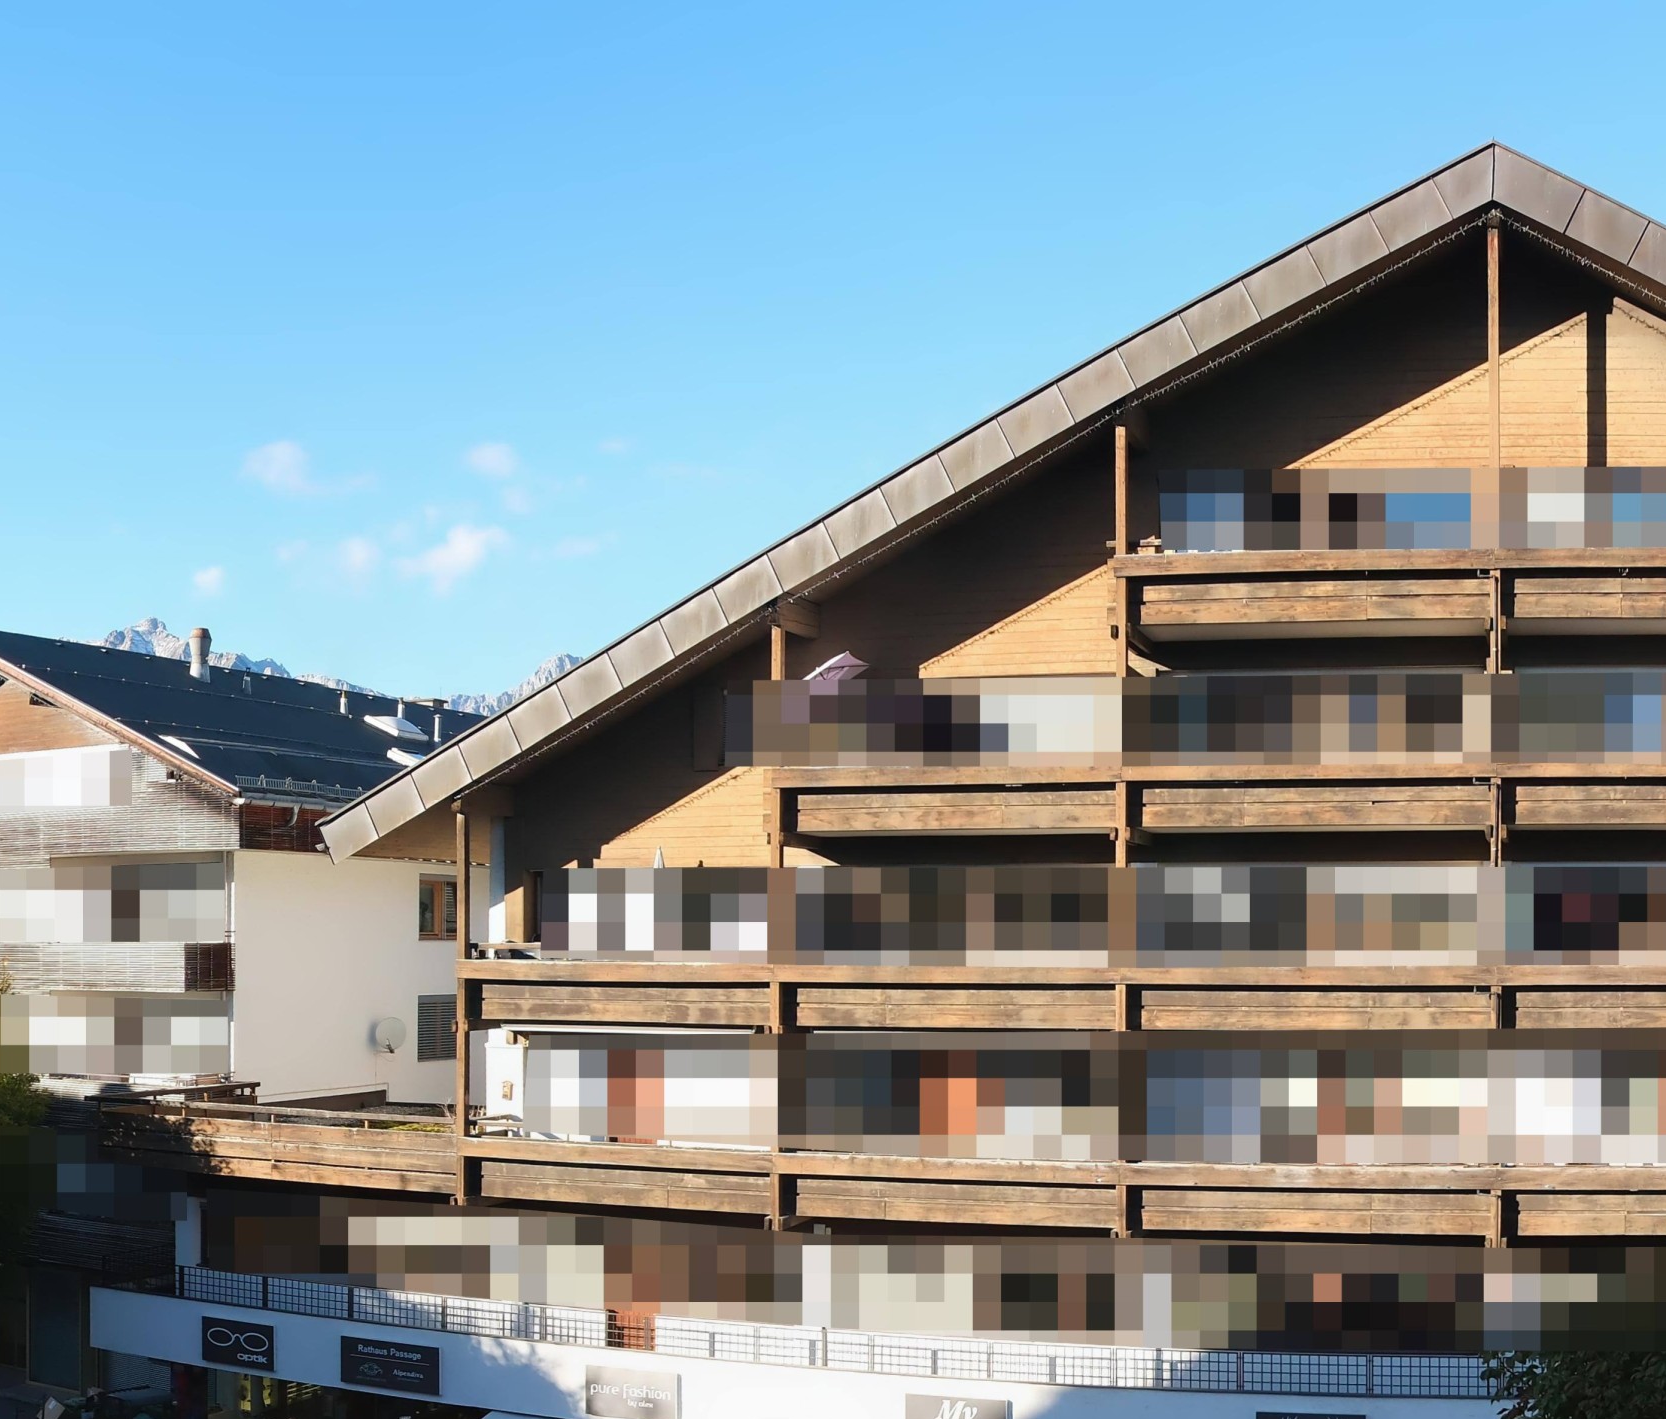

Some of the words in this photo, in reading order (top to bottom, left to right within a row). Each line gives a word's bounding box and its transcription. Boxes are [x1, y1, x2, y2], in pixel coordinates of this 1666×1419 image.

[236, 1352, 269, 1364] optik
[357, 1344, 388, 1356] Rathaus
[390, 1348, 422, 1361] Passage
[590, 1383, 619, 1395] pure
[627, 1399, 637, 1407] by
